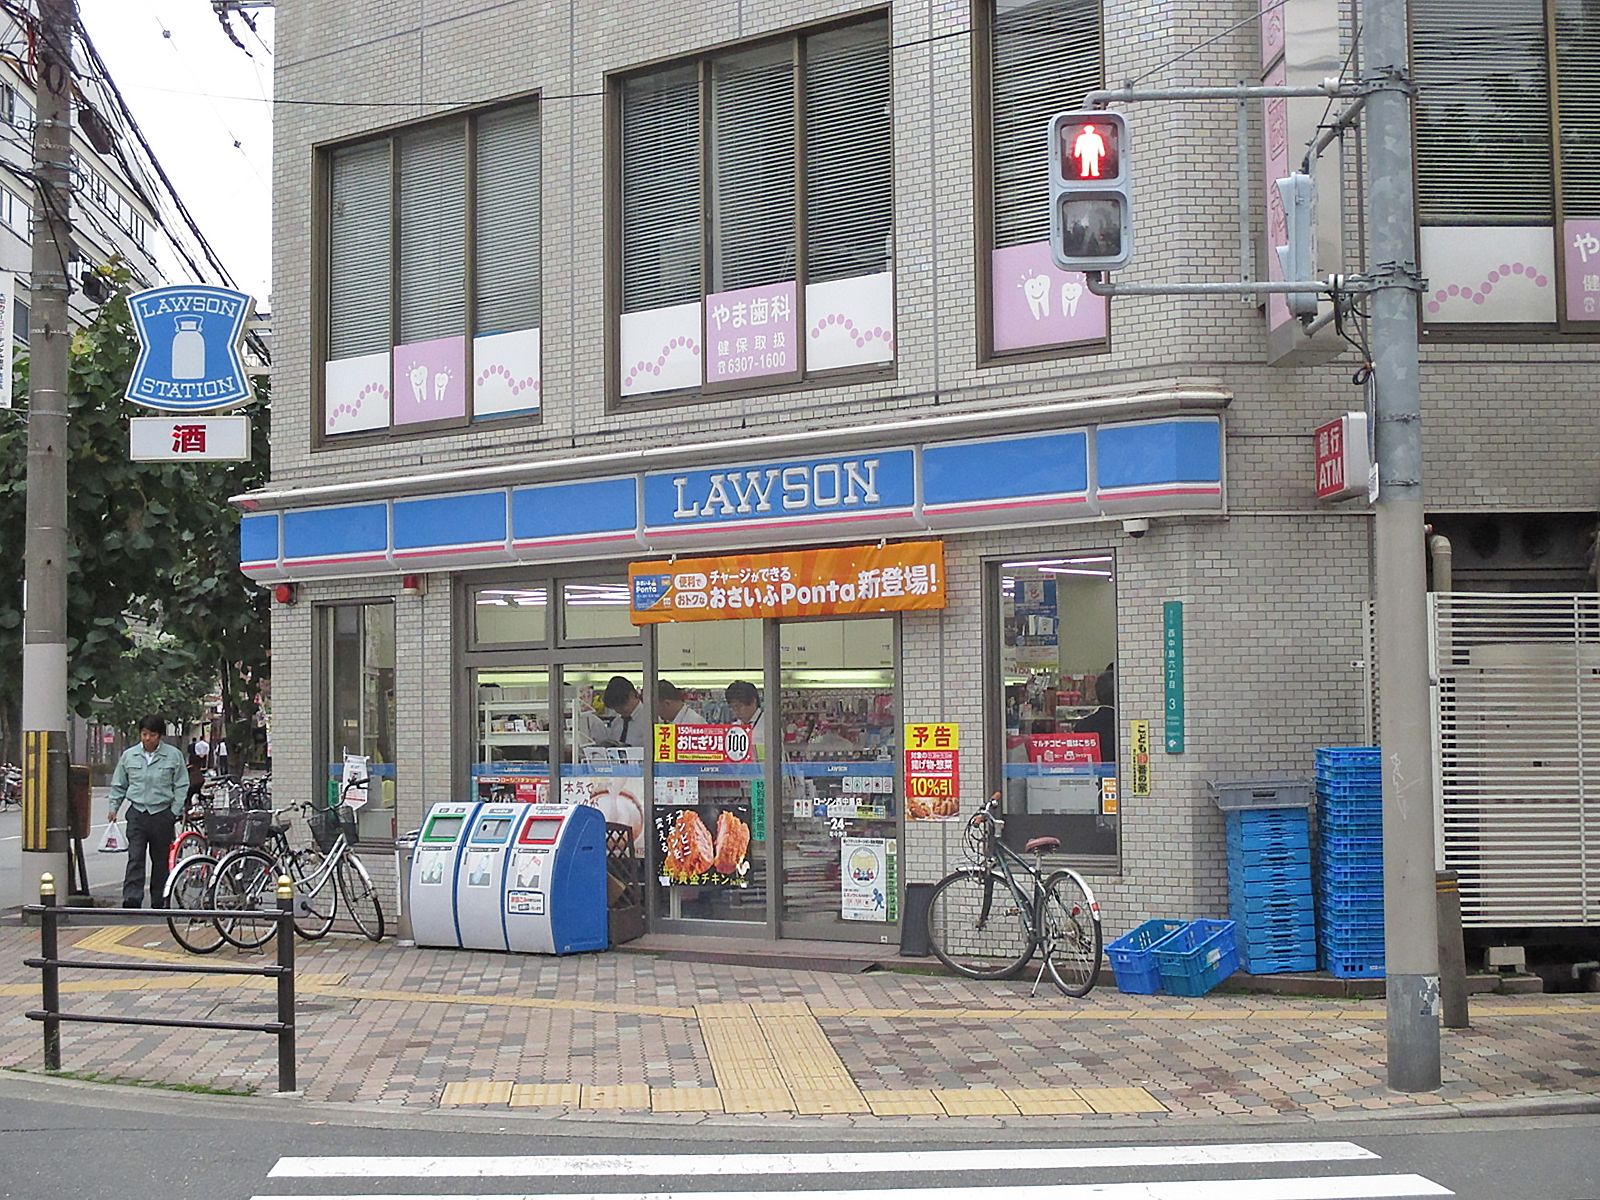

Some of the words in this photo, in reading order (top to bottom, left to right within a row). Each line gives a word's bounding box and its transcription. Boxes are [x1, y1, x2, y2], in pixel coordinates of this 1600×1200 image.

[140, 296, 237, 319] LAWSON
[712, 294, 791, 331] やま歯科
[717, 332, 786, 357] 健保取扱
[728, 351, 787, 373] 6307-1600
[141, 376, 235, 399] STATION
[171, 424, 207, 454] 酒
[1319, 426, 1340, 458] 銀行
[1319, 457, 1342, 491] ATM
[673, 459, 880, 519] LAWSON
[709, 566, 791, 585] チャージができる
[636, 586, 657, 594] Ponta
[678, 594, 705, 606] おトクな
[1167, 628, 1176, 689] 西中島六丁目
[1168, 698, 1176, 711] 3
[659, 726, 671, 760] 予告
[677, 735, 717, 751] おにぎり
[728, 734, 747, 752] 100
[913, 726, 951, 748] 予告
[910, 777, 953, 797] 10%引
